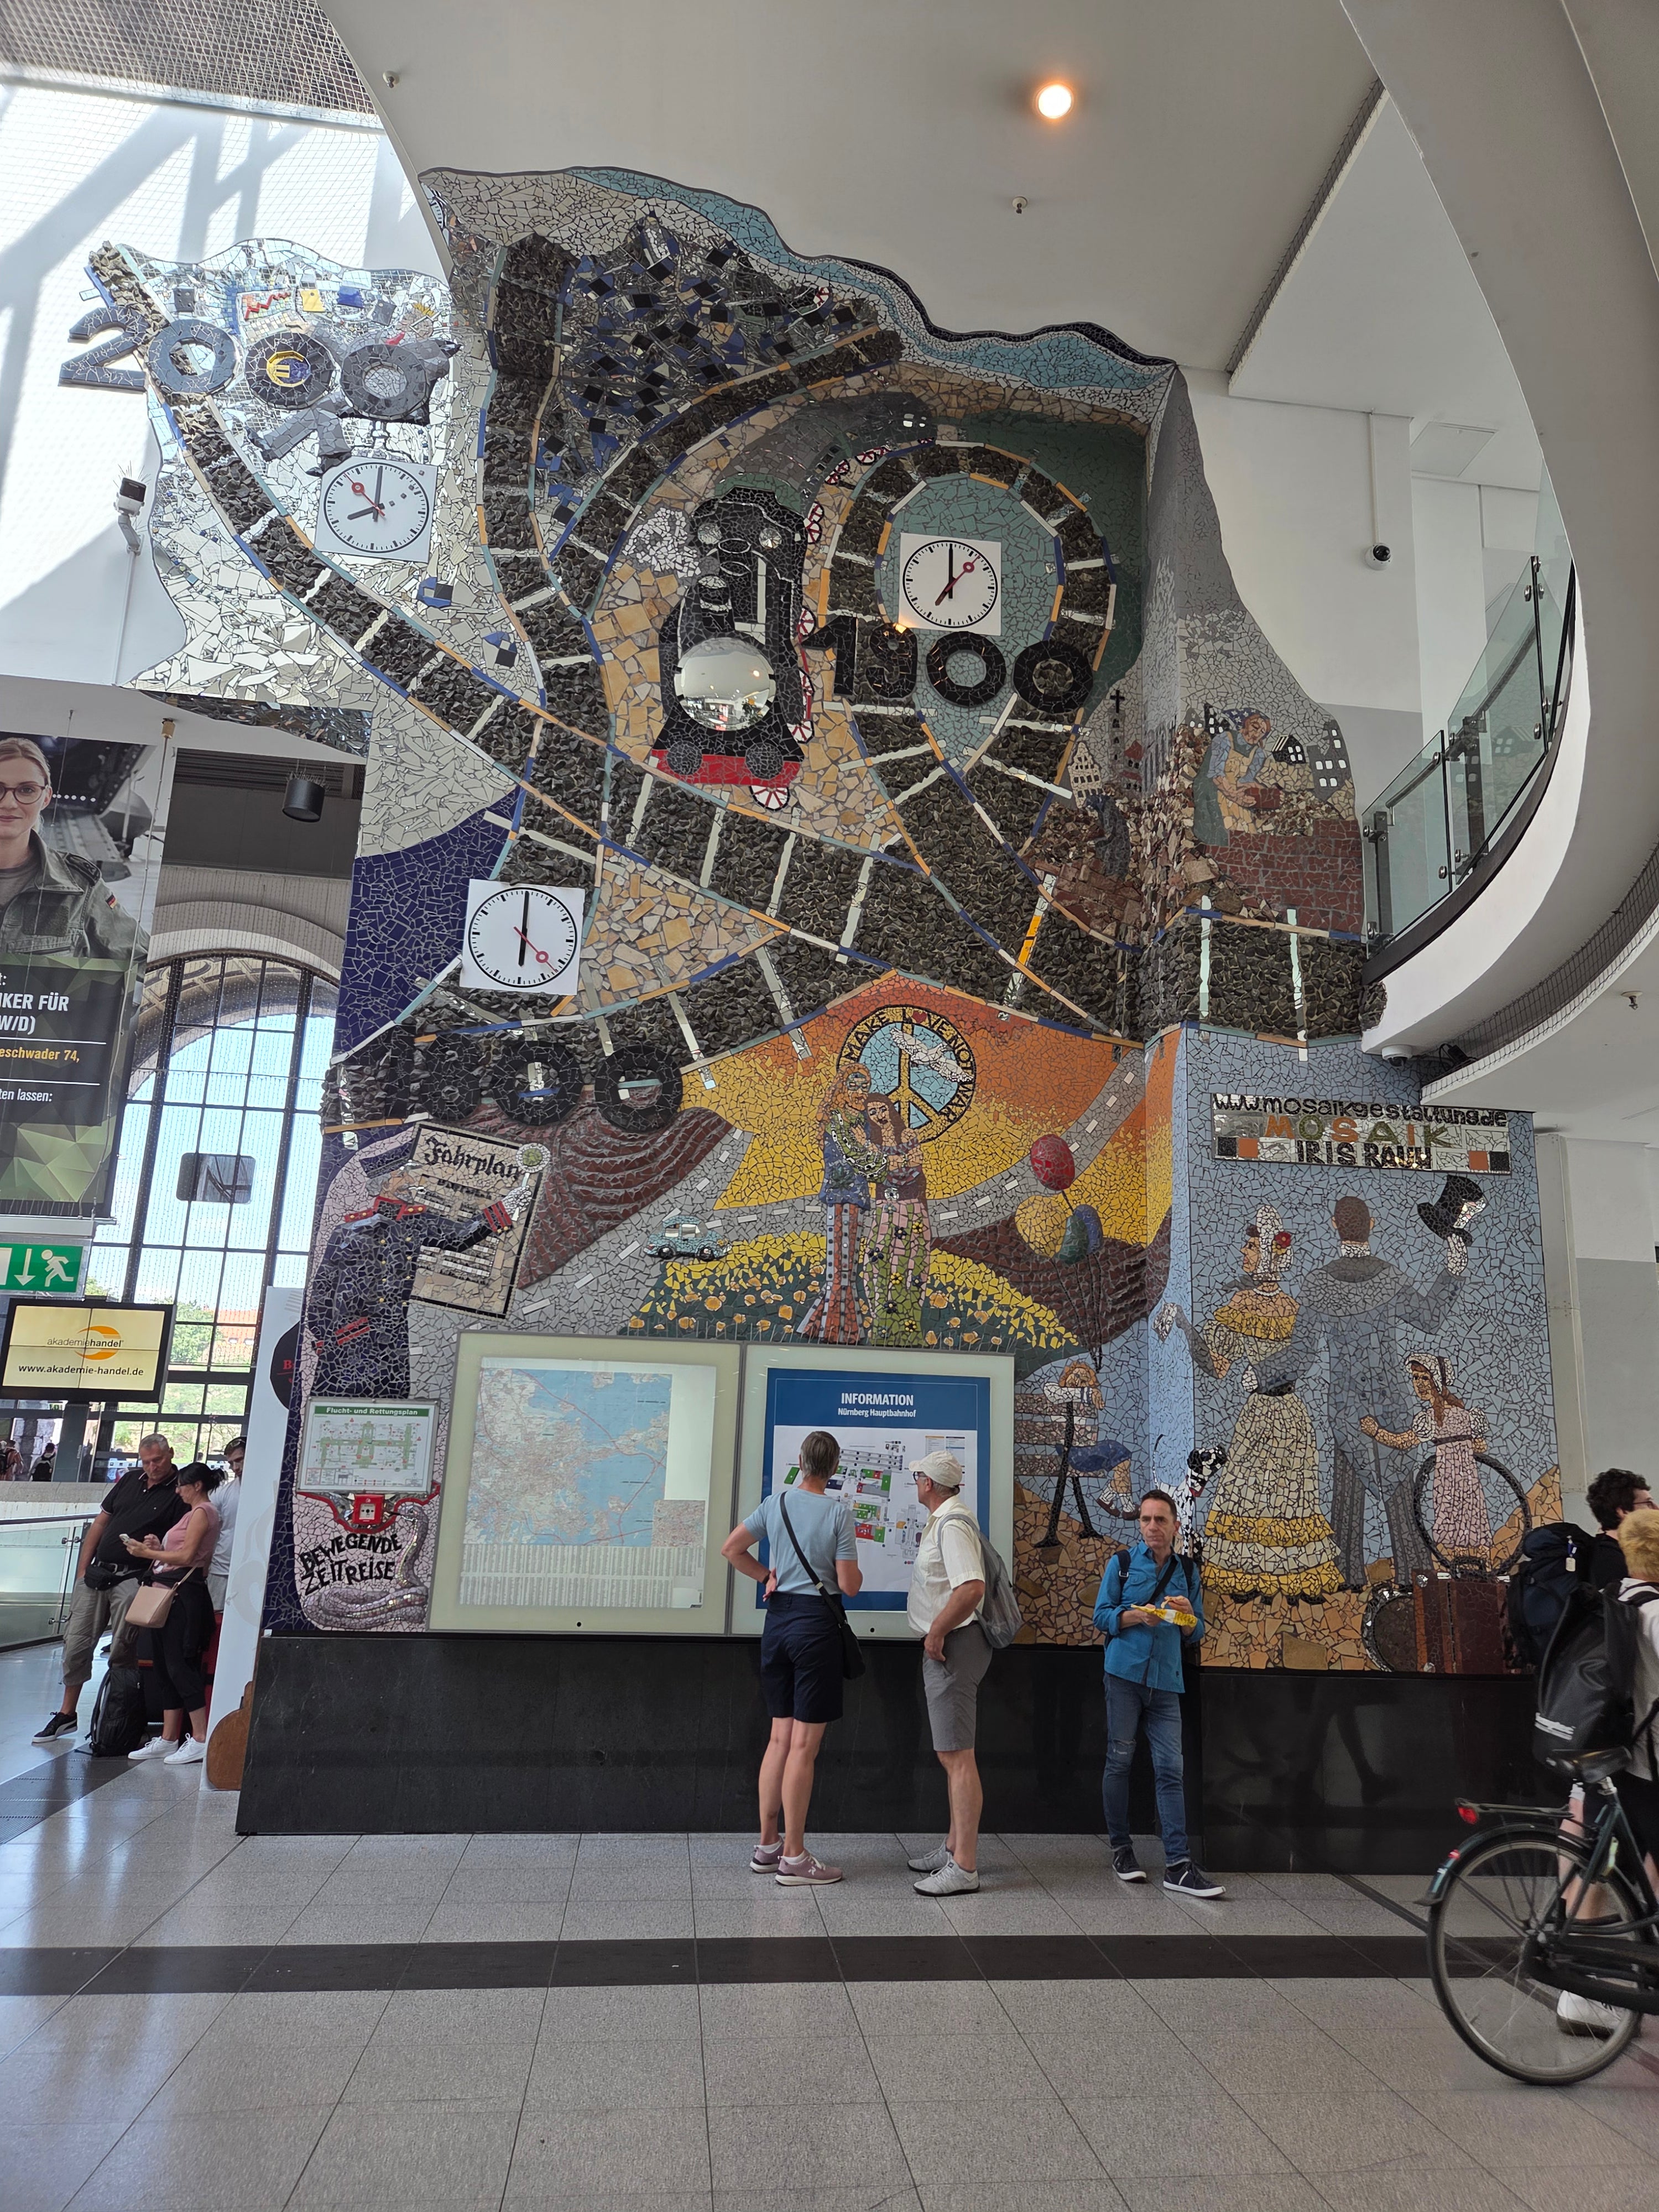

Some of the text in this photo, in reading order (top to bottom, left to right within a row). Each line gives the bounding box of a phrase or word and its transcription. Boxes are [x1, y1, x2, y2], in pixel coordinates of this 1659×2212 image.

[801, 615, 1093, 713] 1900
[38, 992, 69, 1011] FÜR
[841, 1012, 889, 1062] MAKE
[64, 1050, 80, 1063] 74,
[17, 1088, 53, 1102] lassen:
[1265, 1114, 1454, 1149] MOSAIK
[424, 1136, 520, 1181] Fahrplan
[1297, 1139, 1357, 1165] IRIS
[18, 1365, 144, 1376] www.akademie-handel.de
[841, 1392, 914, 1406] INFORMATION
[838, 1407, 916, 1418] Nürnberg Hauptbahnhof
[300, 1533, 402, 1574] BEWEGENDE
[301, 1557, 395, 1596] ZEITREISE
